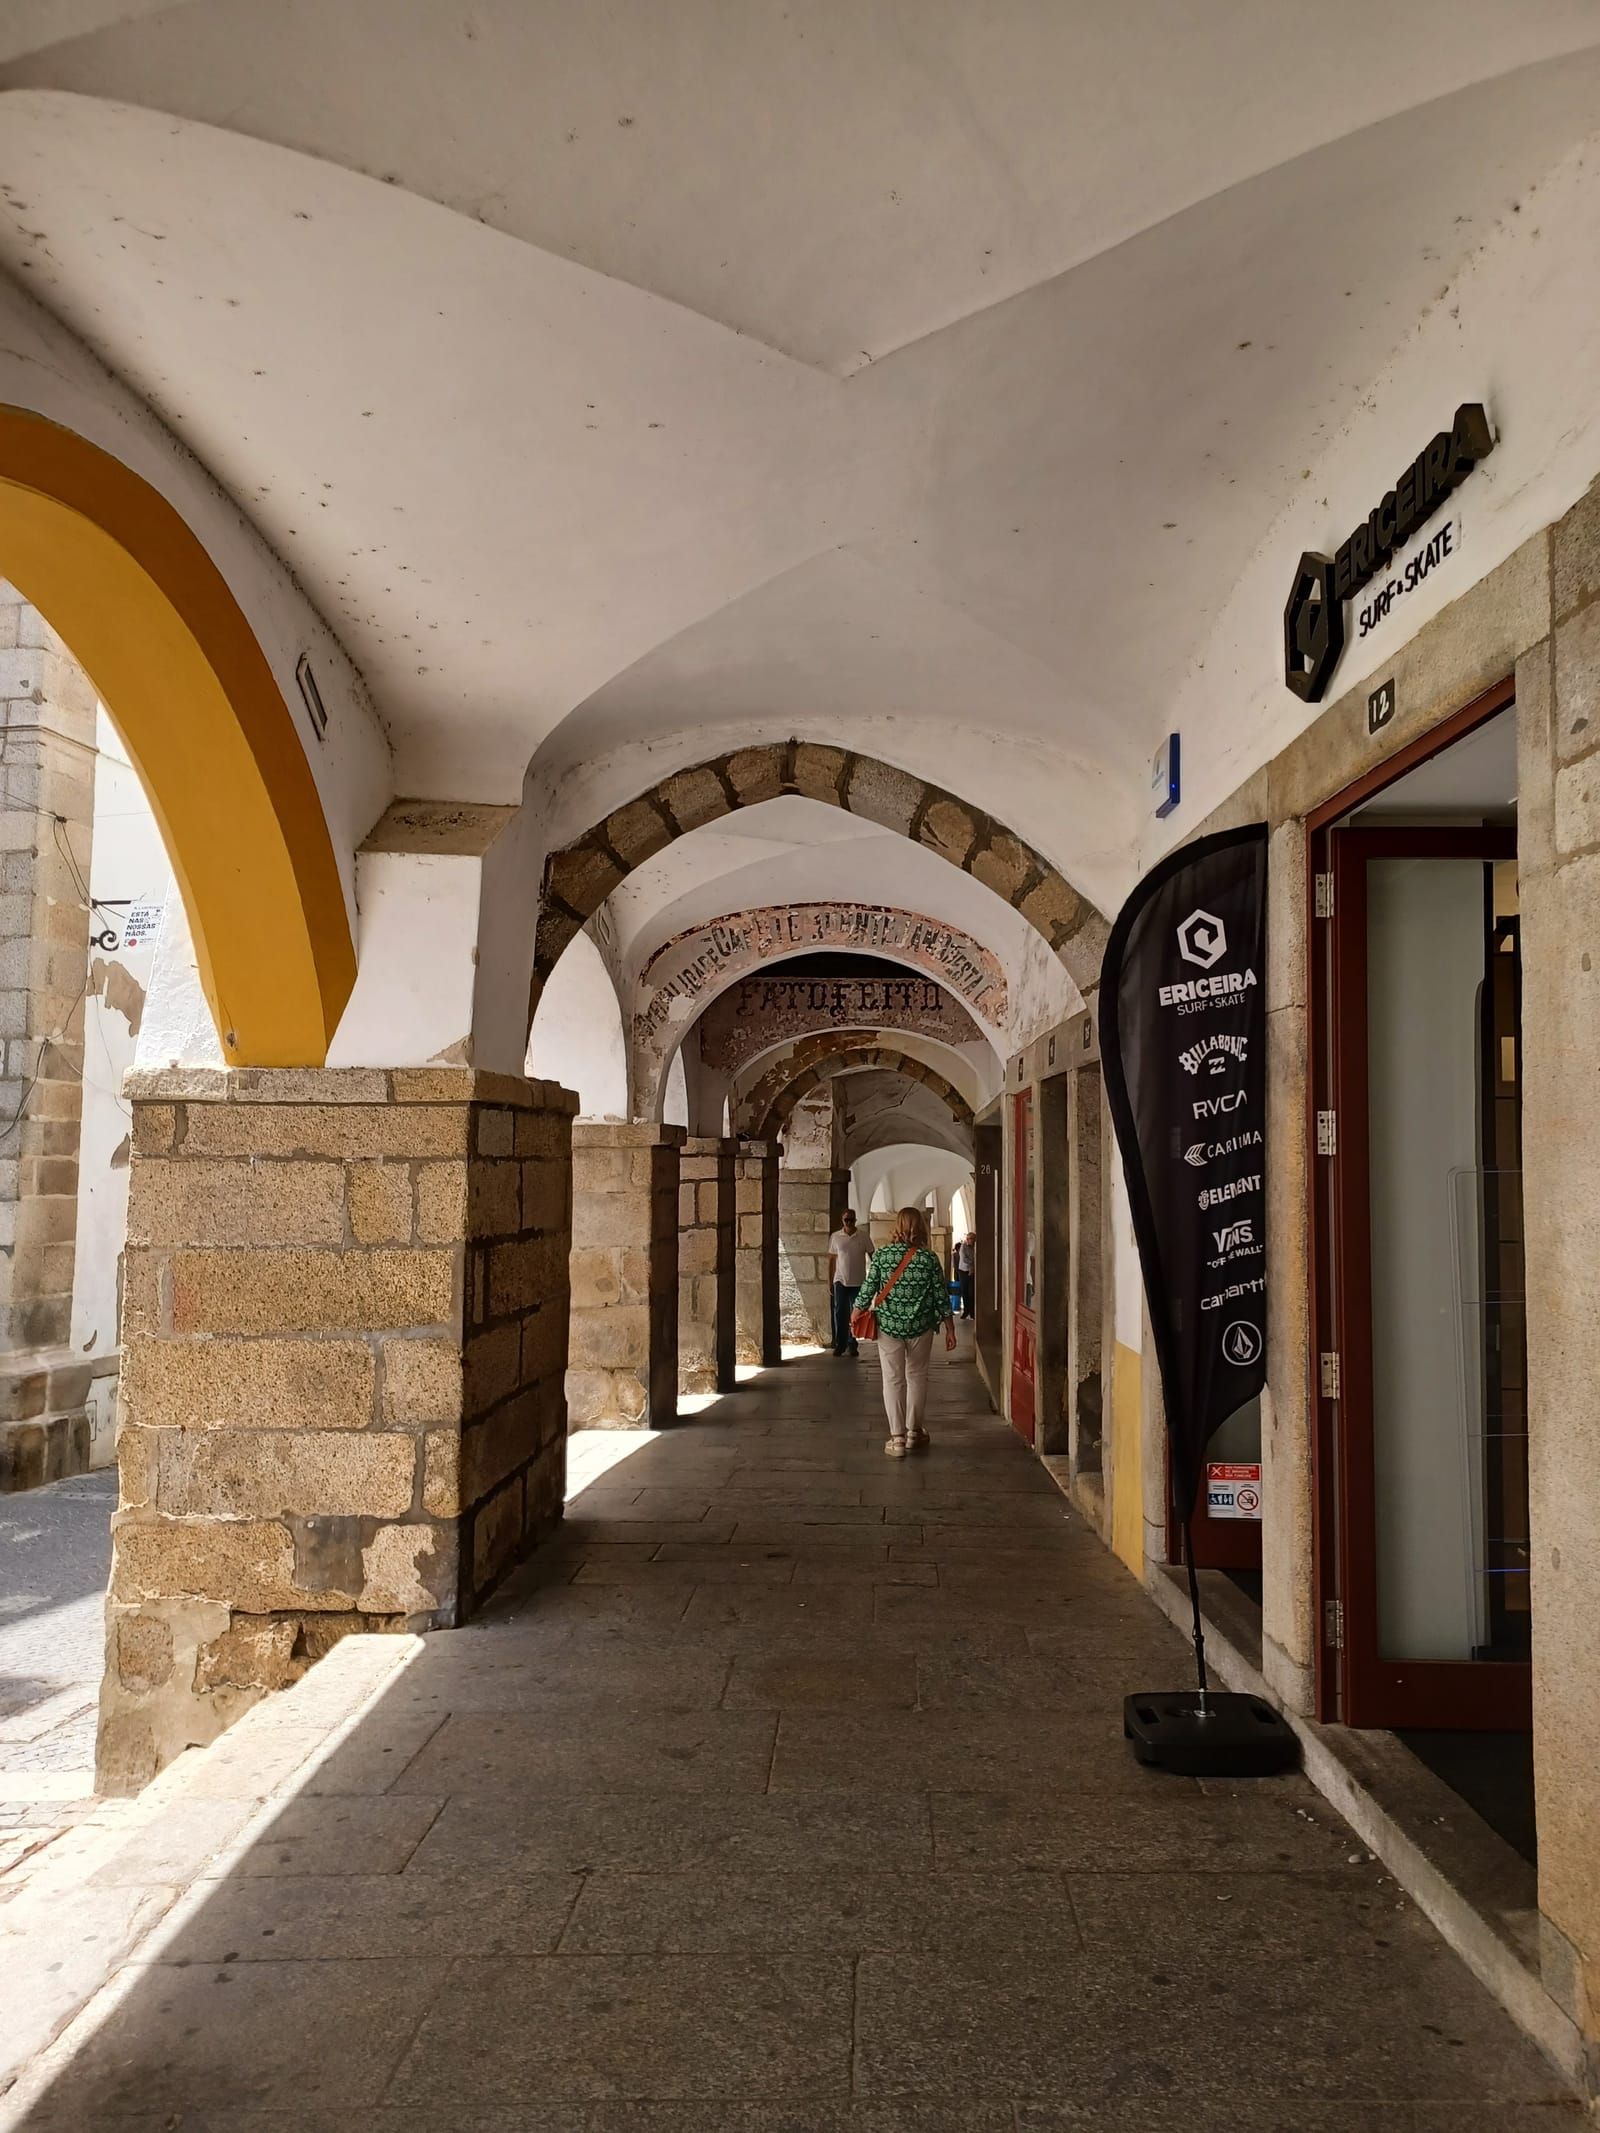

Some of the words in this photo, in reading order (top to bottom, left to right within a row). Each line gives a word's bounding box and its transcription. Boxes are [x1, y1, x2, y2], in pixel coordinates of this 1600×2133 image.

[1335, 403, 1493, 600] ERICEIRA
[1359, 580, 1396, 638] SURF
[1405, 521, 1453, 593] SKATE
[1373, 690, 1390, 723] 12
[1158, 968, 1257, 1007] ERICEIRA
[1177, 1000, 1208, 1016] SURF
[1215, 992, 1246, 1009] SKATE
[1178, 1034, 1248, 1075] BILLABONG
[1192, 1089, 1248, 1120] RVCA
[1209, 1174, 1261, 1206] ELEMENT
[1212, 1219, 1252, 1253] VANS
